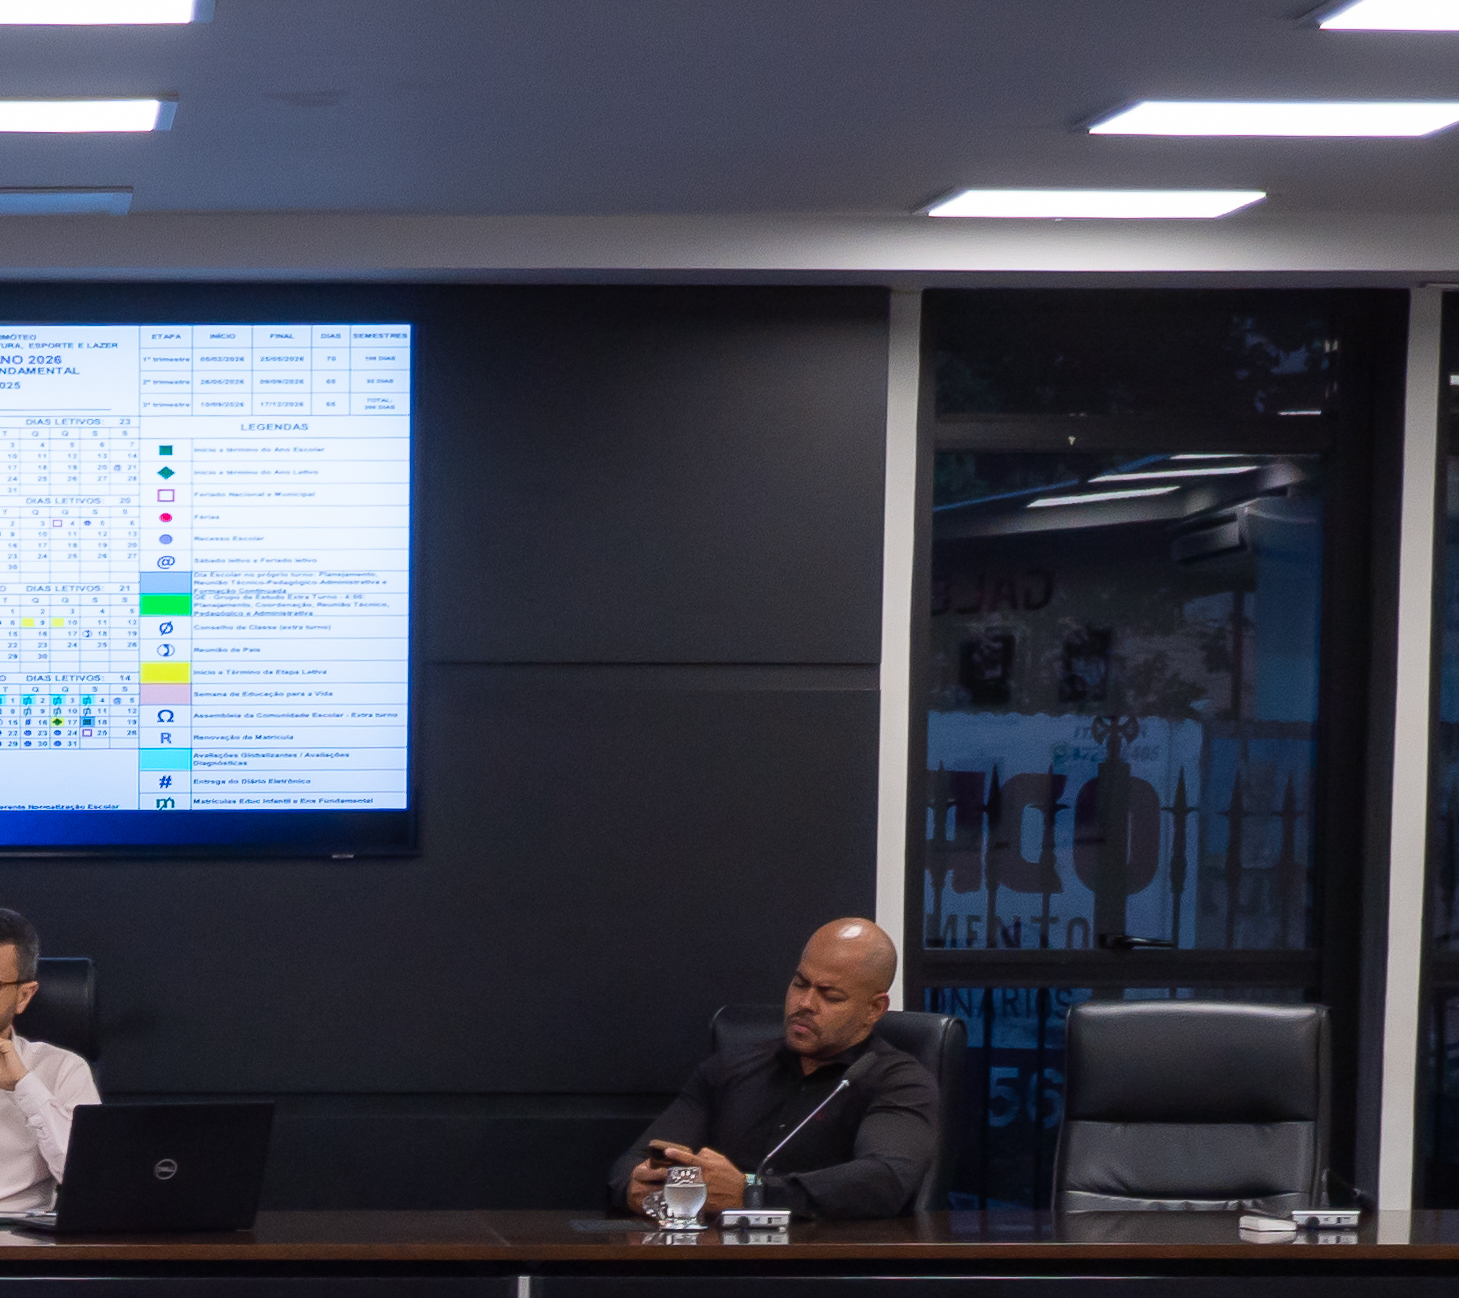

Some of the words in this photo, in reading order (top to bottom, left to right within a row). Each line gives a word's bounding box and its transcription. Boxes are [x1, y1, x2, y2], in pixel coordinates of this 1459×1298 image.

[29, 355, 62, 364] 2026
[26, 417, 51, 425] DIAS
[161, 732, 172, 744] R
